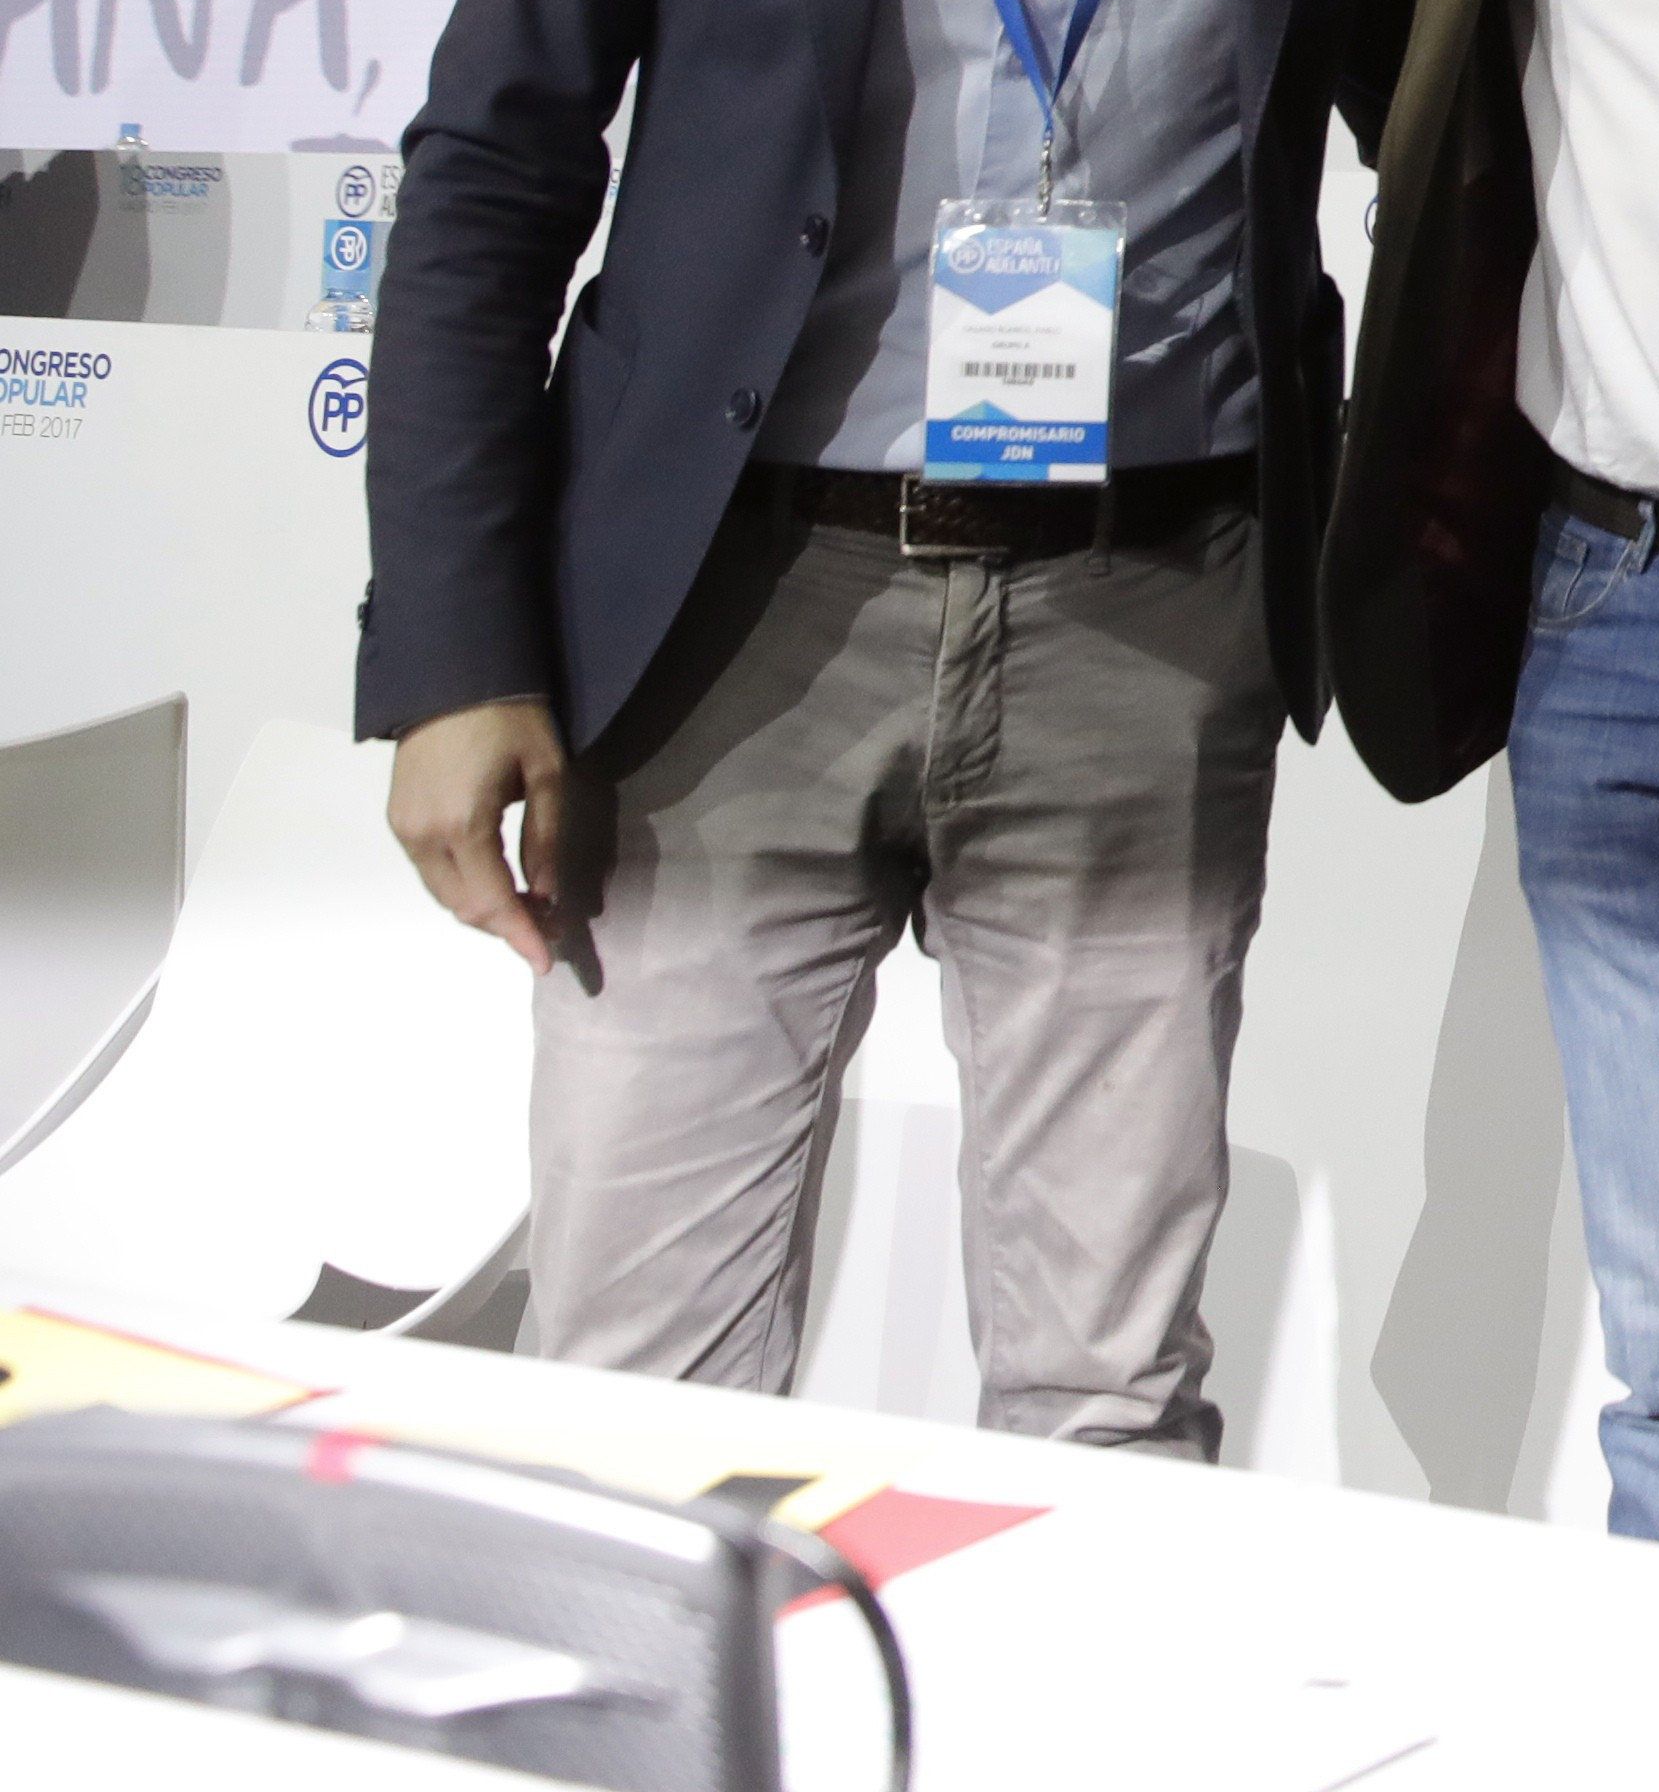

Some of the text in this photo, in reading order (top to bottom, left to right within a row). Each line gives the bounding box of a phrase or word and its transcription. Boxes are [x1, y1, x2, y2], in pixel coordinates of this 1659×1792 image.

[144, 165, 222, 182] CONGRESO
[145, 182, 209, 198] POPULAR
[1, 413, 83, 439] FEB 2017
[951, 424, 1086, 444] COMPROMISARIO
